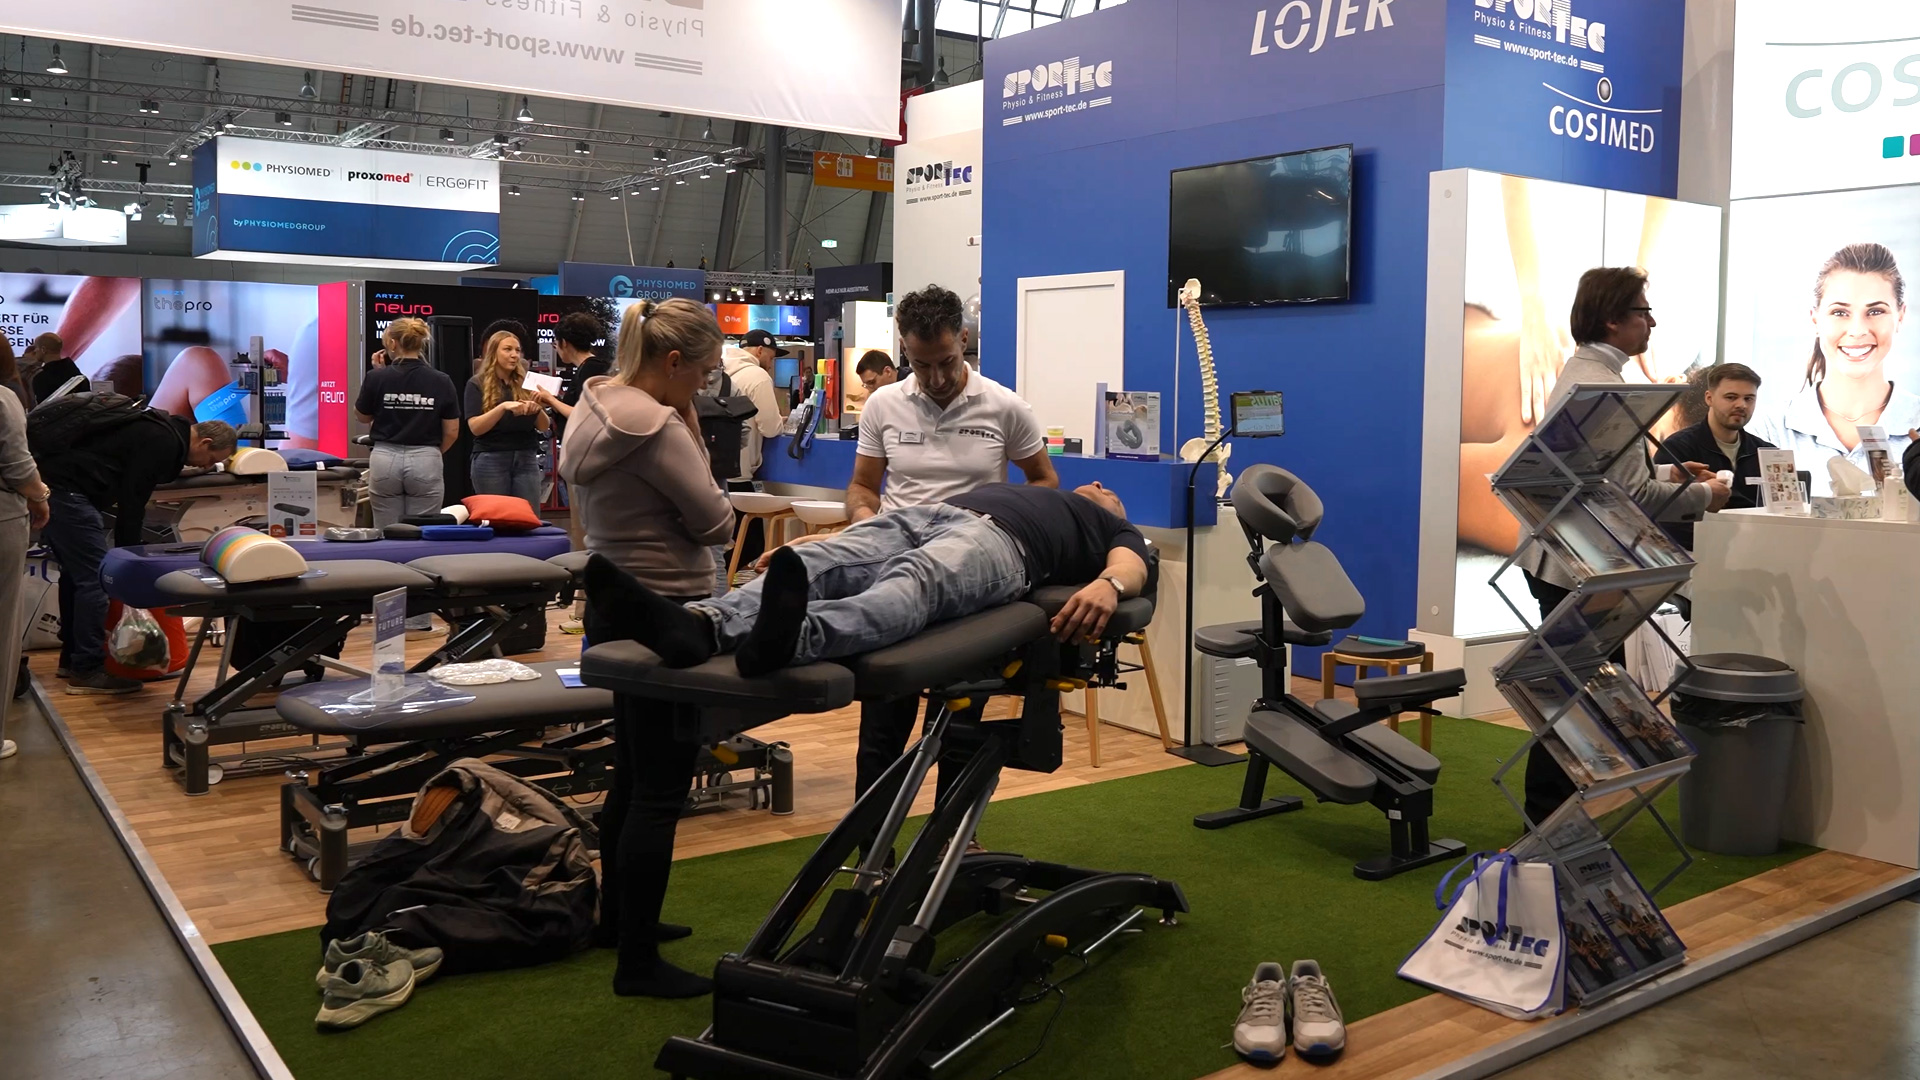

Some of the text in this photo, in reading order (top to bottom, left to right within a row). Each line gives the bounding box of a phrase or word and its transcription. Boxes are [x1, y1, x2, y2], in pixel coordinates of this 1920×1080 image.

[1250, 0, 1394, 56] LOJER
[1474, 10, 1552, 40] Physio & Fitness
[1475, 0, 1606, 54] ORTEC
[1504, 41, 1579, 68] www.sport-tec.de
[1003, 90, 1063, 110] Physio & Fitness
[1025, 101, 1088, 121] www.sport-tec.de
[1549, 105, 1655, 153] COSIMED
[266, 164, 331, 177] PHYSIOMED
[427, 176, 489, 190] ERGOFIT
[920, 191, 958, 202] www.sport-tec.de
[636, 279, 697, 290] PHYSIOMED
[636, 290, 673, 299] GROUP
[154, 297, 212, 313] thepro
[375, 303, 433, 315] neuro
[0, 312, 49, 324] RT FÜR
[537, 329, 555, 337] TOD
[320, 391, 345, 403] neuro
[378, 616, 404, 631] FUTURE
[1466, 948, 1523, 966] www.sport-tec.de
